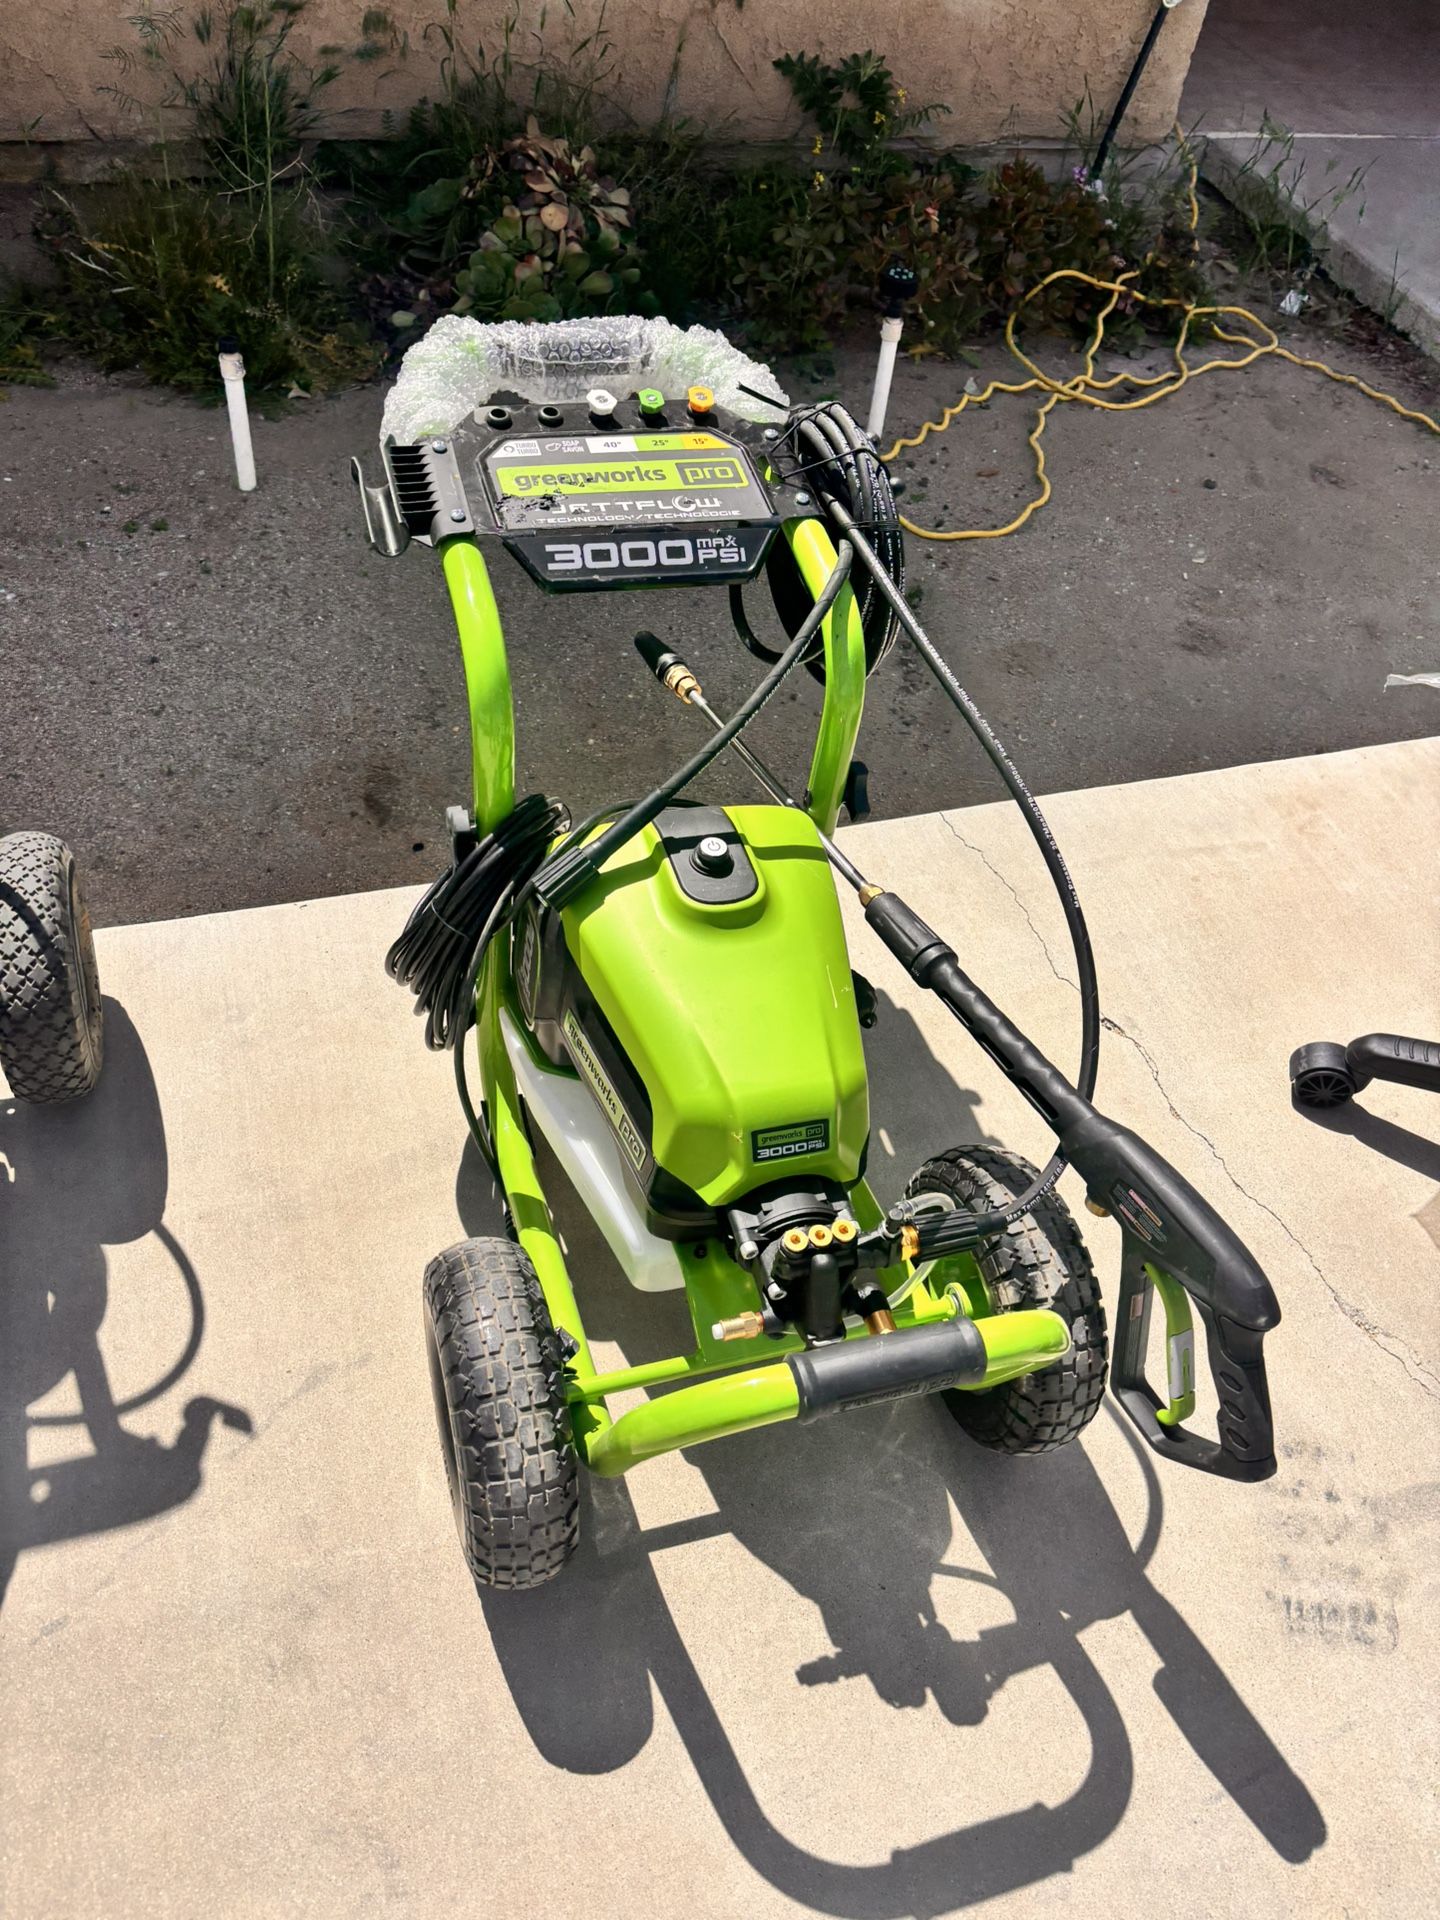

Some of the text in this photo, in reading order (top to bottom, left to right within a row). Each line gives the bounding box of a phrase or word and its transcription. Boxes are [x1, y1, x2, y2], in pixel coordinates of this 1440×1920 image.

[603, 441, 622, 449] 40°
[514, 466, 734, 491] greenworks pro
[545, 539, 694, 571] 3000
[698, 548, 746, 564] PSI
[808, 1126, 821, 1137] pro
[621, 1123, 641, 1158] pro
[808, 1142, 826, 1150] PSI
[757, 1142, 808, 1158] 3000
[1005, 1211, 1022, 1222] Max
[1022, 1195, 1041, 1212] Temp
